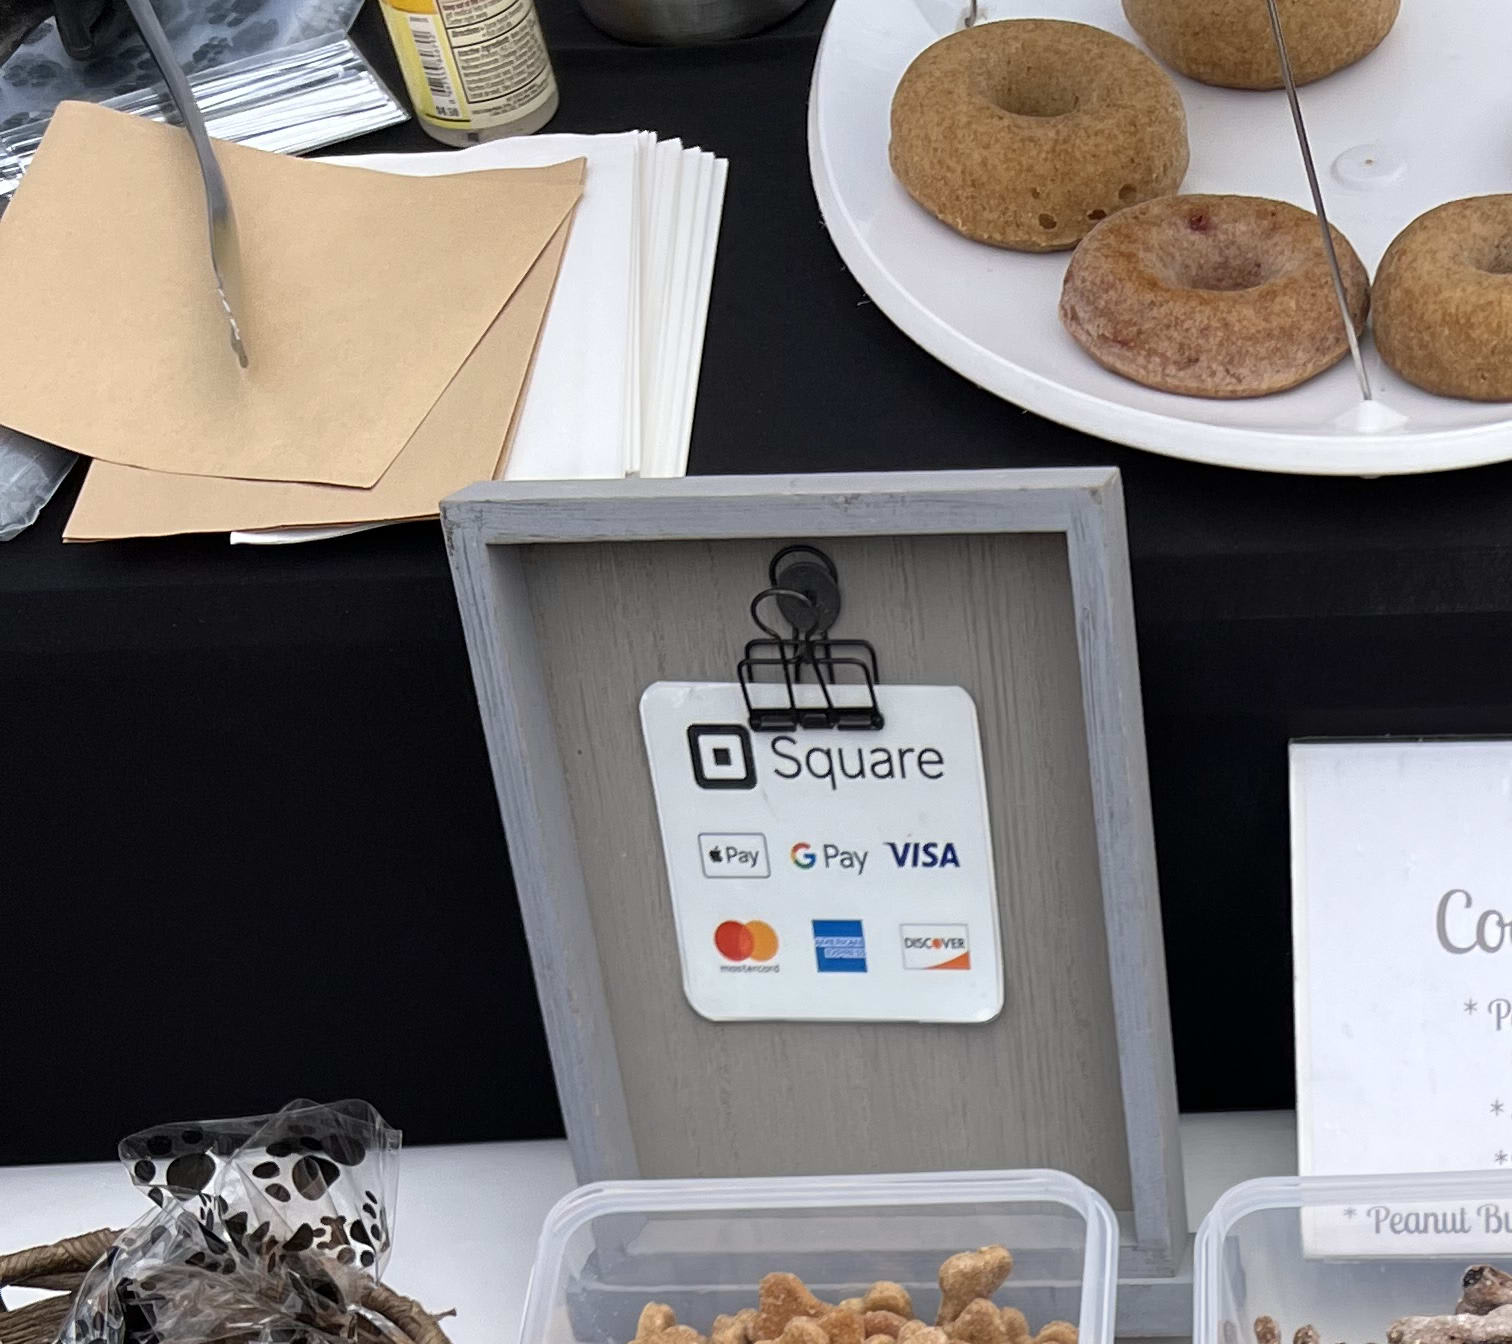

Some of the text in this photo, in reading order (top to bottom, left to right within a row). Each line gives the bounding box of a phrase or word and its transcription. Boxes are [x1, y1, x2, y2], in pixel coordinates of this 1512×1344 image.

[770, 735, 945, 791] Square
[726, 844, 760, 869] Pay
[823, 844, 869, 876] Pay
[883, 842, 961, 869] VISA
[903, 937, 967, 951] DISCOVER
[1366, 1205, 1472, 1235] Peanut
